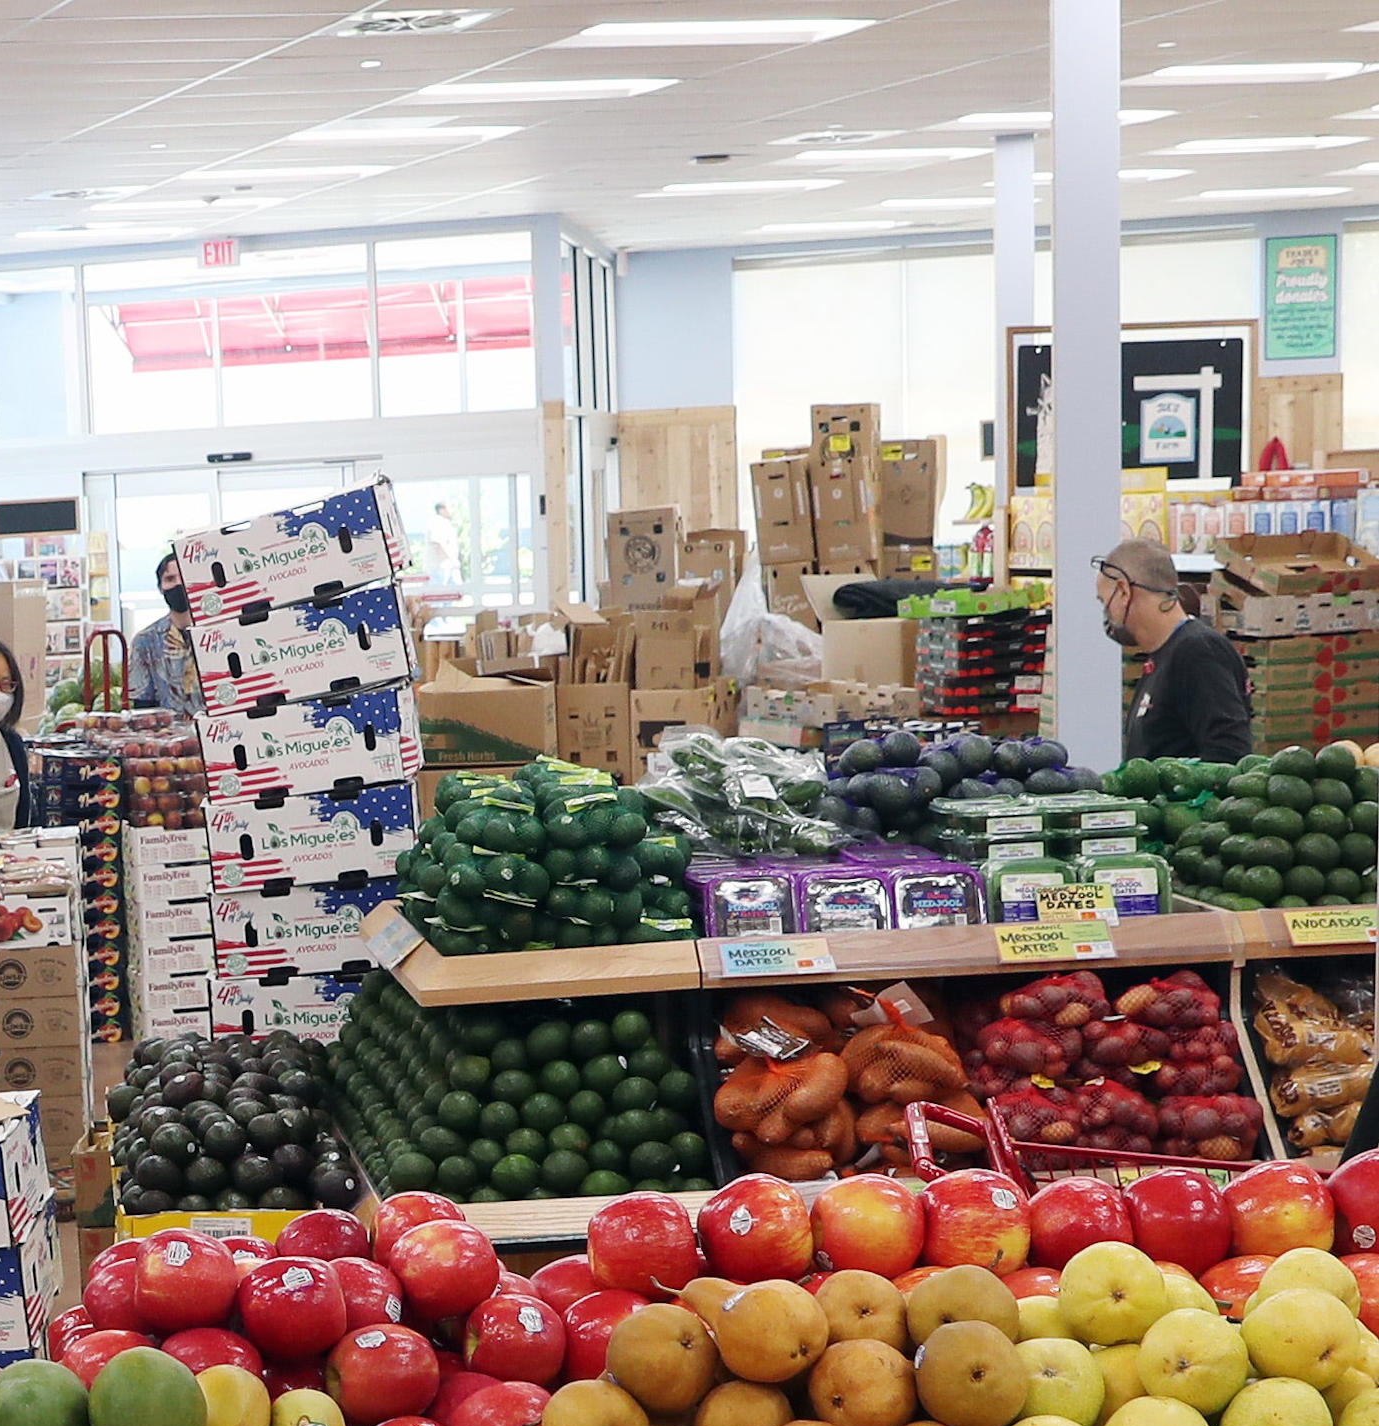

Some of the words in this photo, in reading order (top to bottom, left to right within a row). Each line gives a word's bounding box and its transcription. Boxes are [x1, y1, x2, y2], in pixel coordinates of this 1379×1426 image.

[204, 240, 237, 266] EXIT
[267, 566, 308, 584] AVOCADOS
[284, 660, 325, 676] AVOCADOS
[1039, 891, 1104, 903] MEDJOOL
[1046, 900, 1097, 910] DATES
[1291, 915, 1374, 930] AVOCADOS
